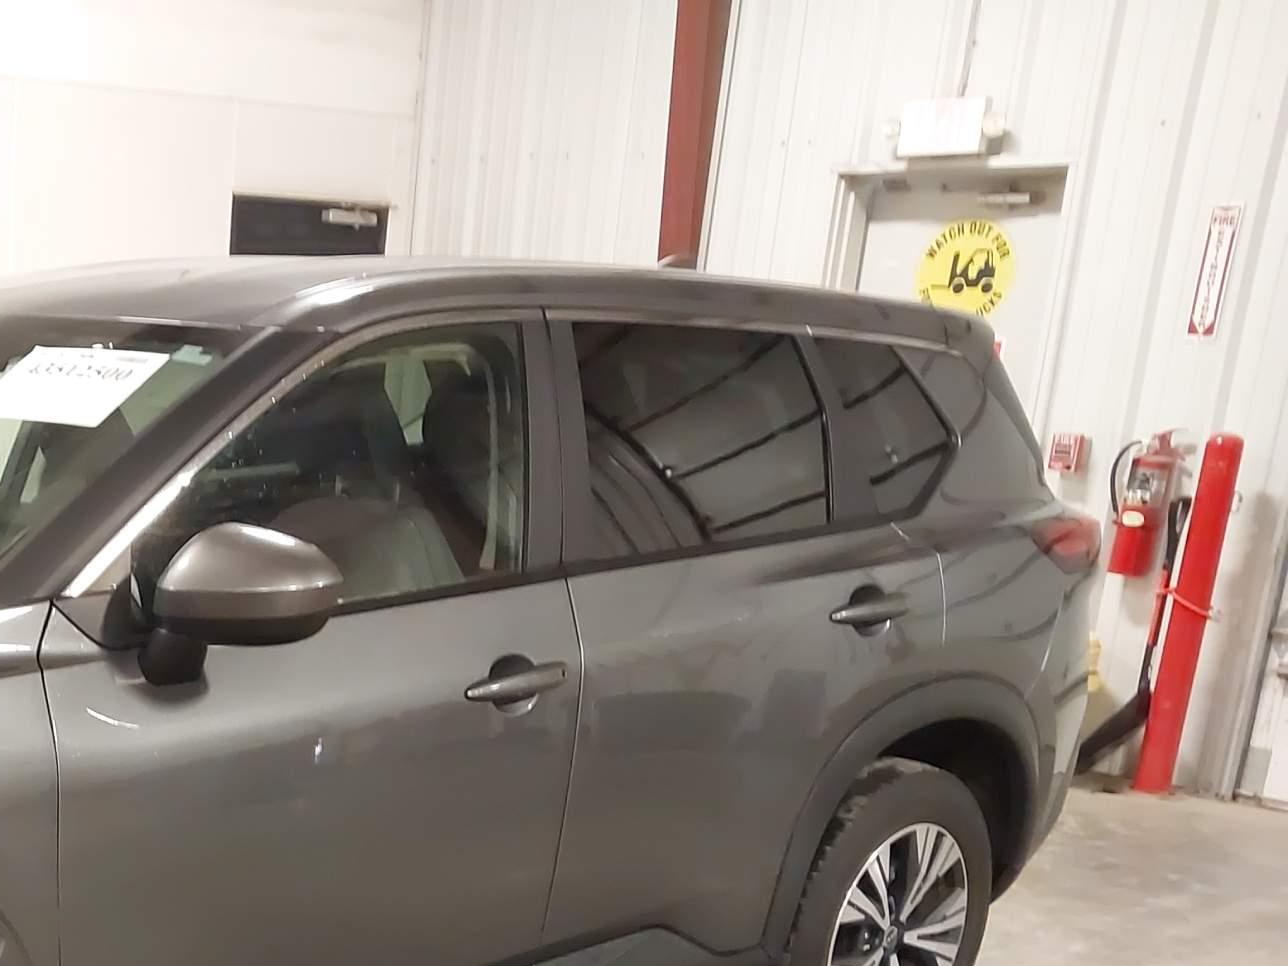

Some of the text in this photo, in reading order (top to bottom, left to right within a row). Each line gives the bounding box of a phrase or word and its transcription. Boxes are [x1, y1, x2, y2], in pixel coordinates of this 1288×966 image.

[1213, 215, 1236, 226] FIRE
[926, 221, 1010, 259] WATCH OUT FOR
